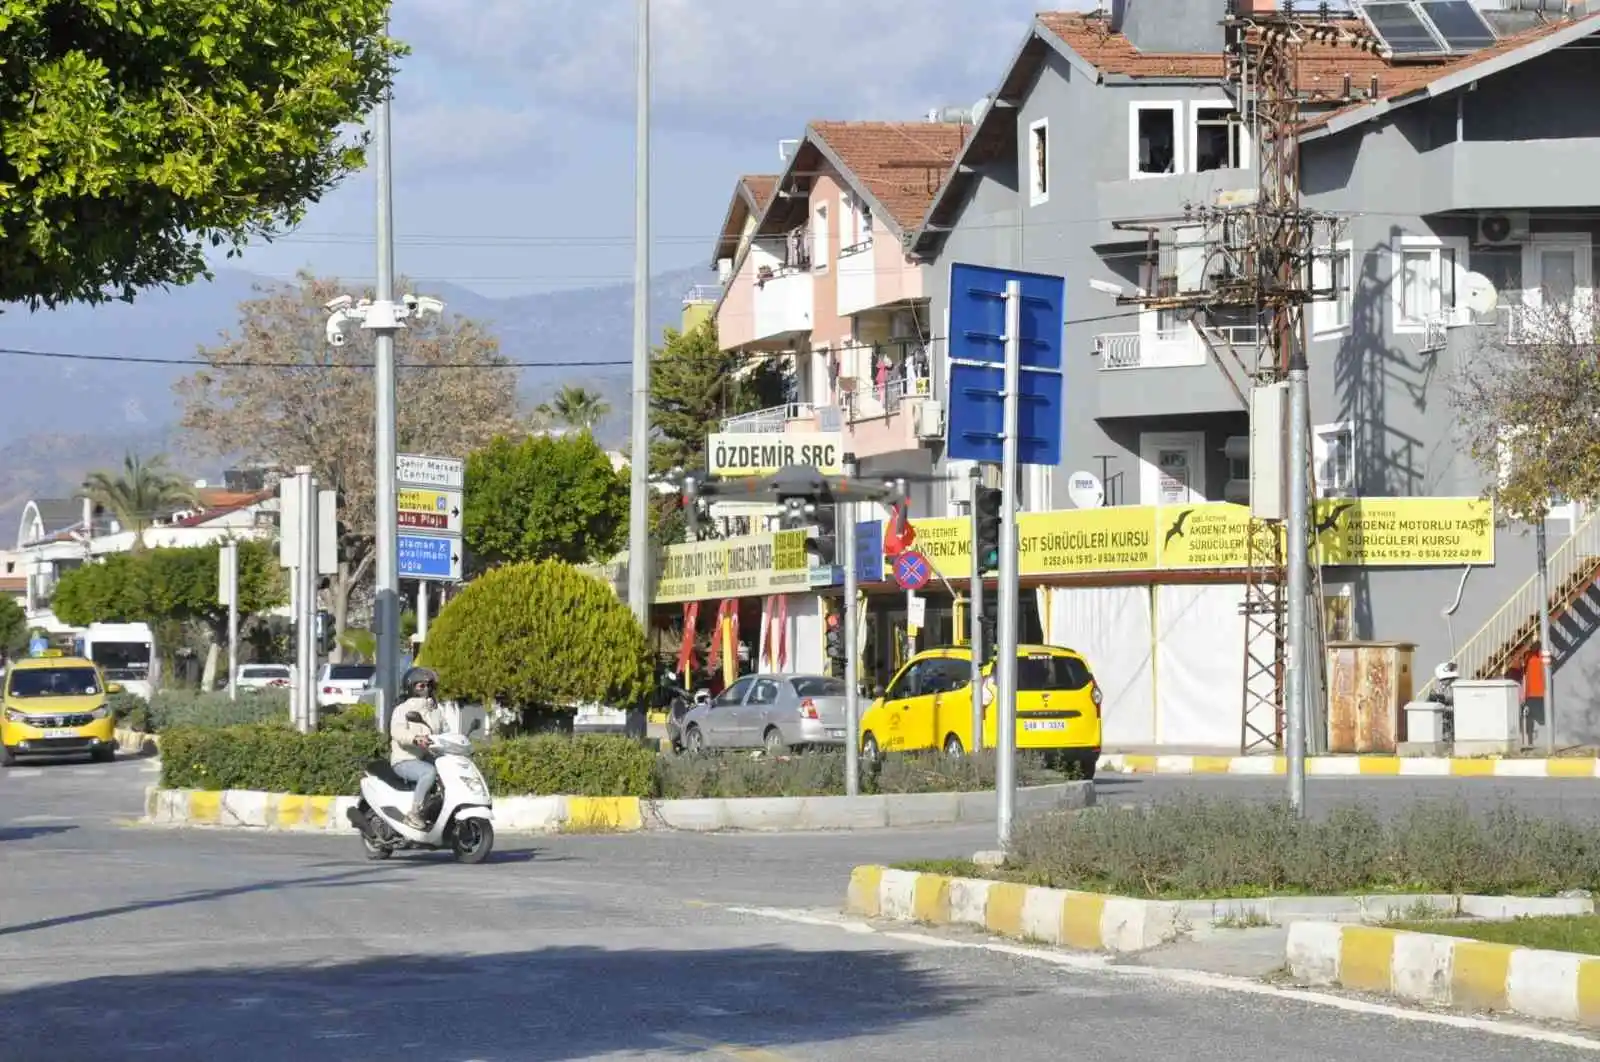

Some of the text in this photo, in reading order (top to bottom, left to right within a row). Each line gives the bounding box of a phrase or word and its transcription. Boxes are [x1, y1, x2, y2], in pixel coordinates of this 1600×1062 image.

[716, 440, 835, 468] ÖZDEMİR SRC
[399, 502, 434, 511] astanesi
[1399, 519, 1452, 530] MOTORLU
[399, 540, 434, 551] alaman
[1016, 536, 1038, 556] AŞIT
[1111, 531, 1149, 547] KURSU
[1422, 535, 1460, 545] KURSU
[400, 561, 422, 571] uğla
